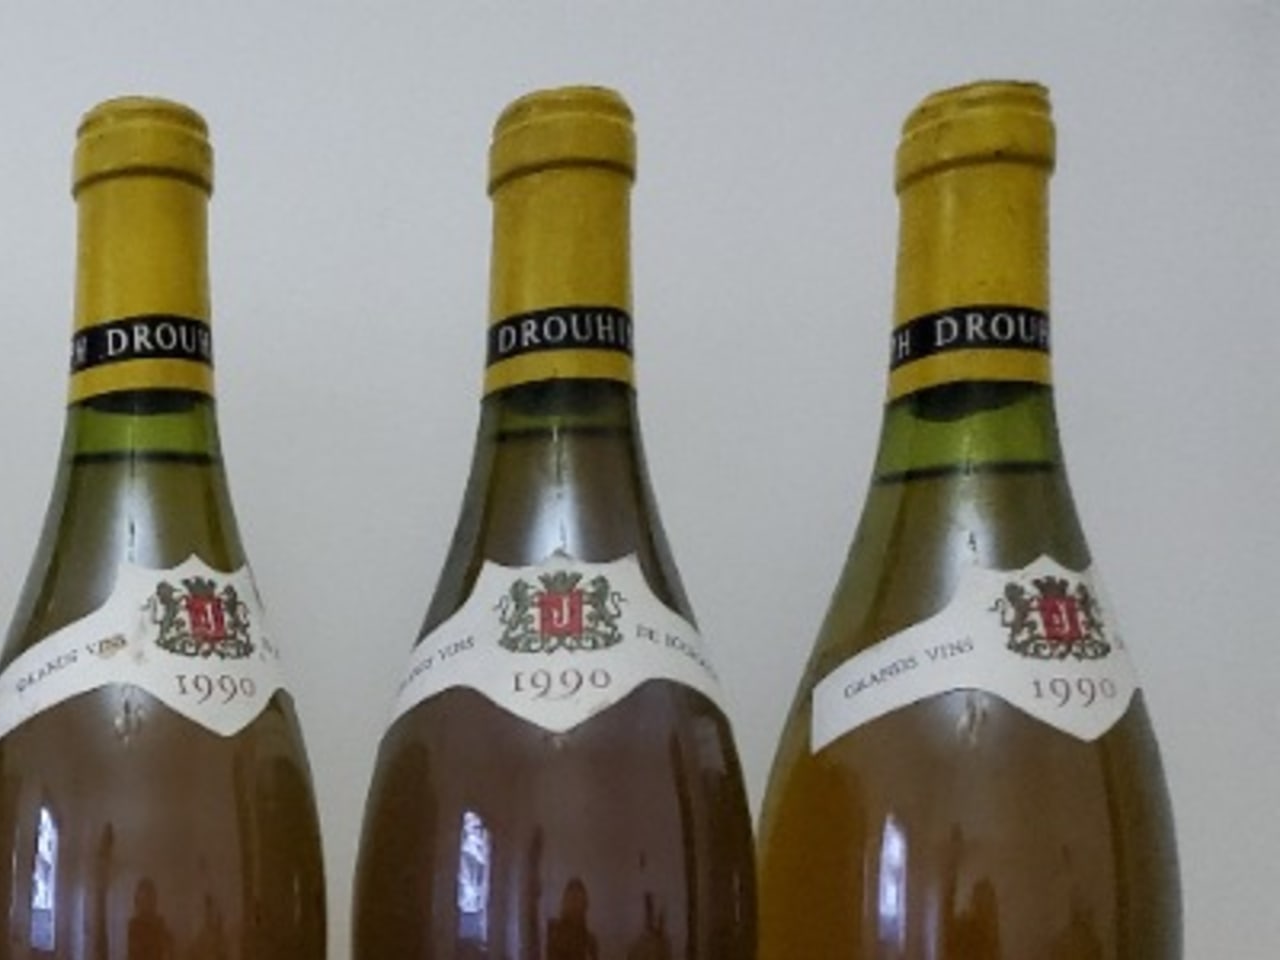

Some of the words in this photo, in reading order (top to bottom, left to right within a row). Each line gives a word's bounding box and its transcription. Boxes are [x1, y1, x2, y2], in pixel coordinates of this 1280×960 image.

[498, 312, 634, 354] DROUHI
[925, 636, 975, 663] VINS
[176, 674, 257, 704] 1990
[513, 669, 612, 699] 1990
[1032, 677, 1117, 709] 1990
